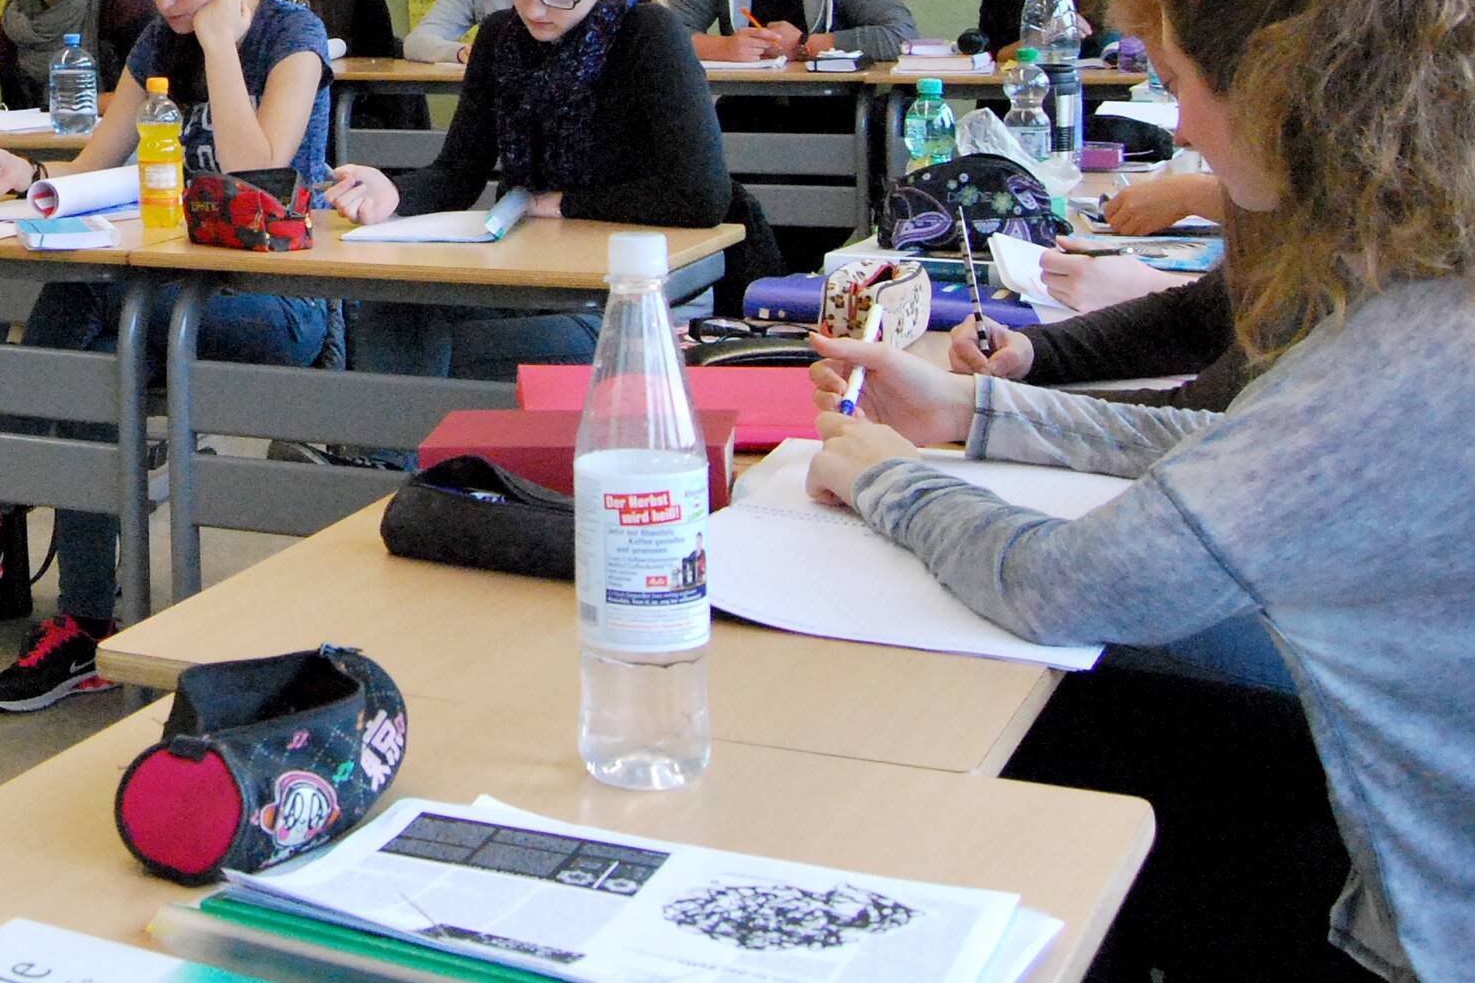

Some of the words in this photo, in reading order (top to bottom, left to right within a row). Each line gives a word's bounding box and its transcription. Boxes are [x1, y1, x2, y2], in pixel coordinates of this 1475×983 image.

[605, 495, 625, 508] Der
[628, 493, 669, 508] Herbst
[621, 510, 649, 524] wird
